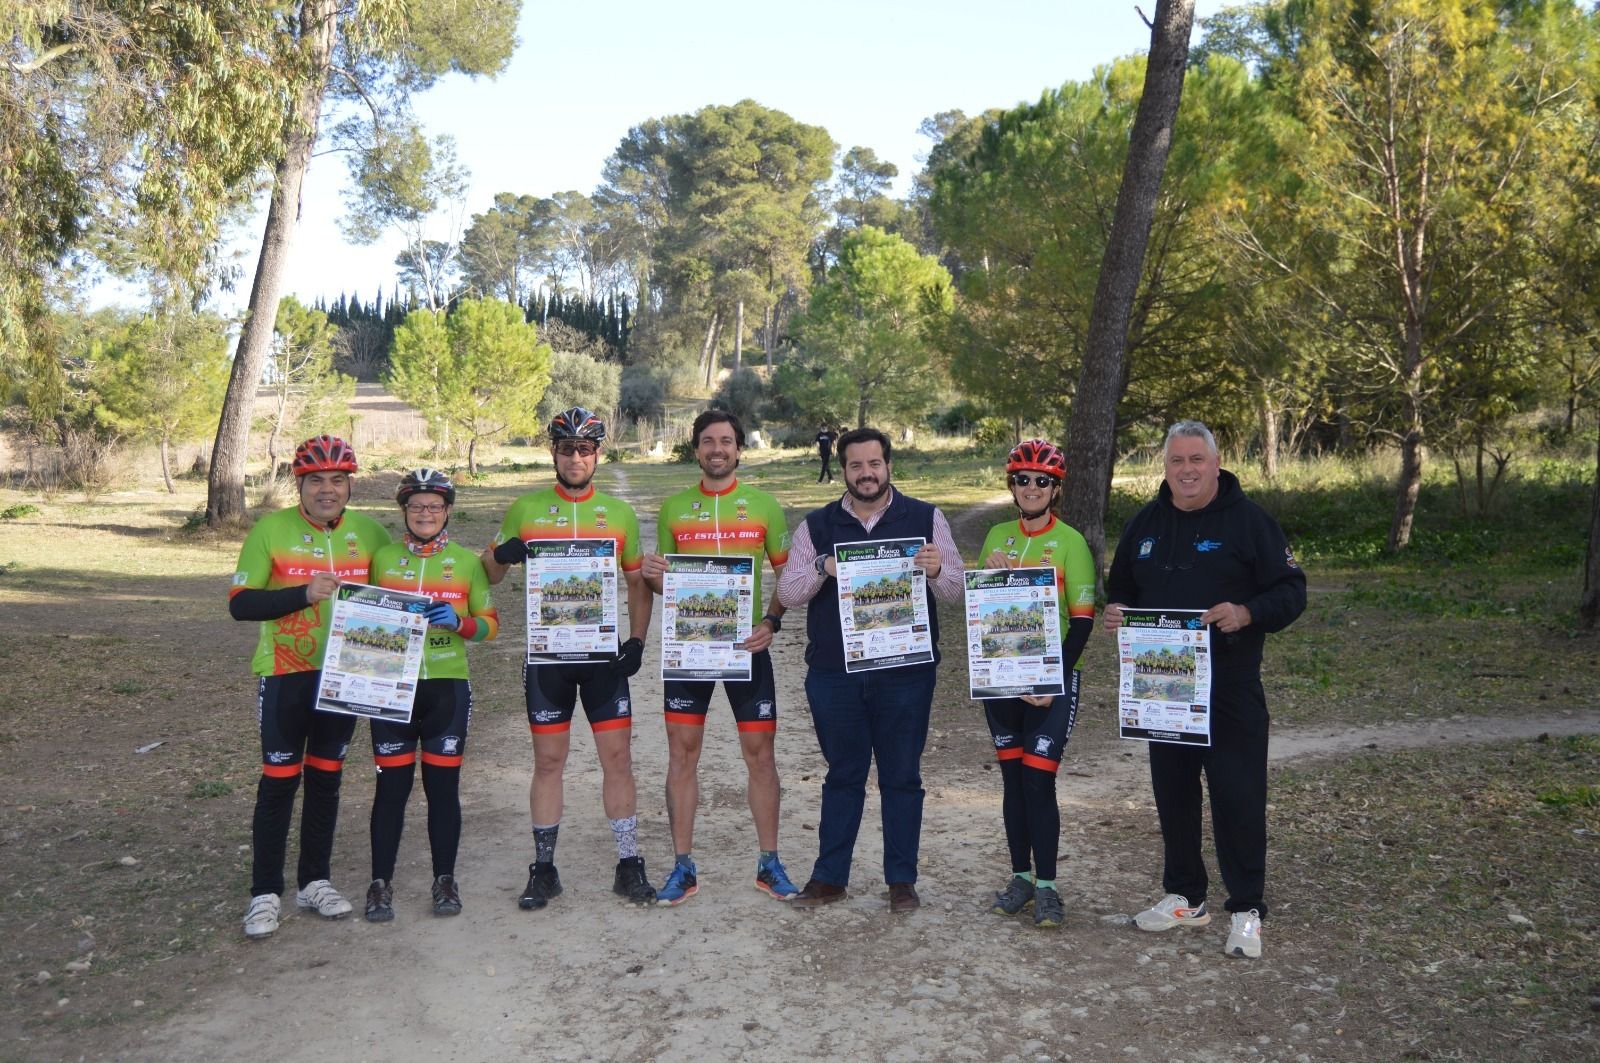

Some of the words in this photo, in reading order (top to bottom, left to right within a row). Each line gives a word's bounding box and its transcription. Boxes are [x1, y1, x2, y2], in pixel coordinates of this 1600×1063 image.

[695, 532, 736, 540] ESTELLA
[570, 544, 589, 553] FRANCO
[880, 546, 900, 554] FRANCO
[839, 551, 847, 561] V
[708, 561, 727, 569] FRANCO
[1009, 574, 1029, 582] FRANCO
[341, 589, 350, 600] V
[384, 594, 403, 606] FRANCO
[1161, 615, 1181, 625] FRANCO
